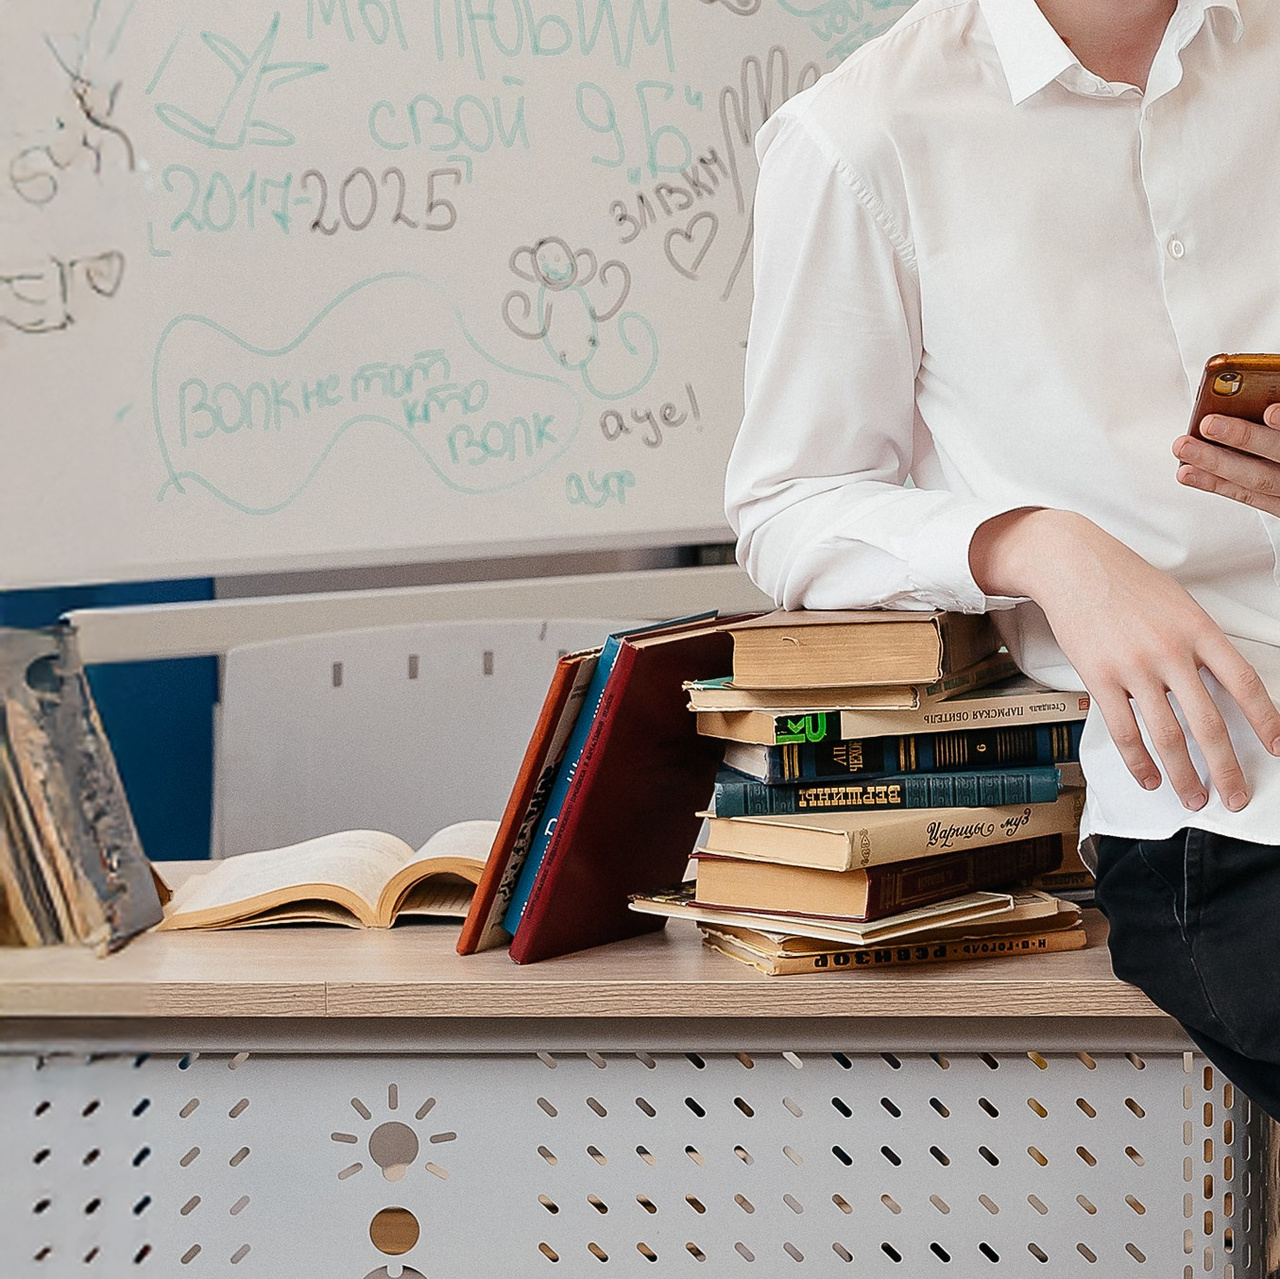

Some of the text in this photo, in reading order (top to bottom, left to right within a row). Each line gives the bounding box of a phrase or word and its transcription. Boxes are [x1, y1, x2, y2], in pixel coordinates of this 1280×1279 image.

[368, 76, 531, 154] СВОЙ
[923, 702, 1067, 725] Стендаль ПАРМСКАЯ ОБИТЕЛЬ
[798, 784, 902, 808] ВЕРШИНЫ
[926, 807, 1032, 849] Царицы муз
[813, 945, 948, 970] РЕВИЗОР
